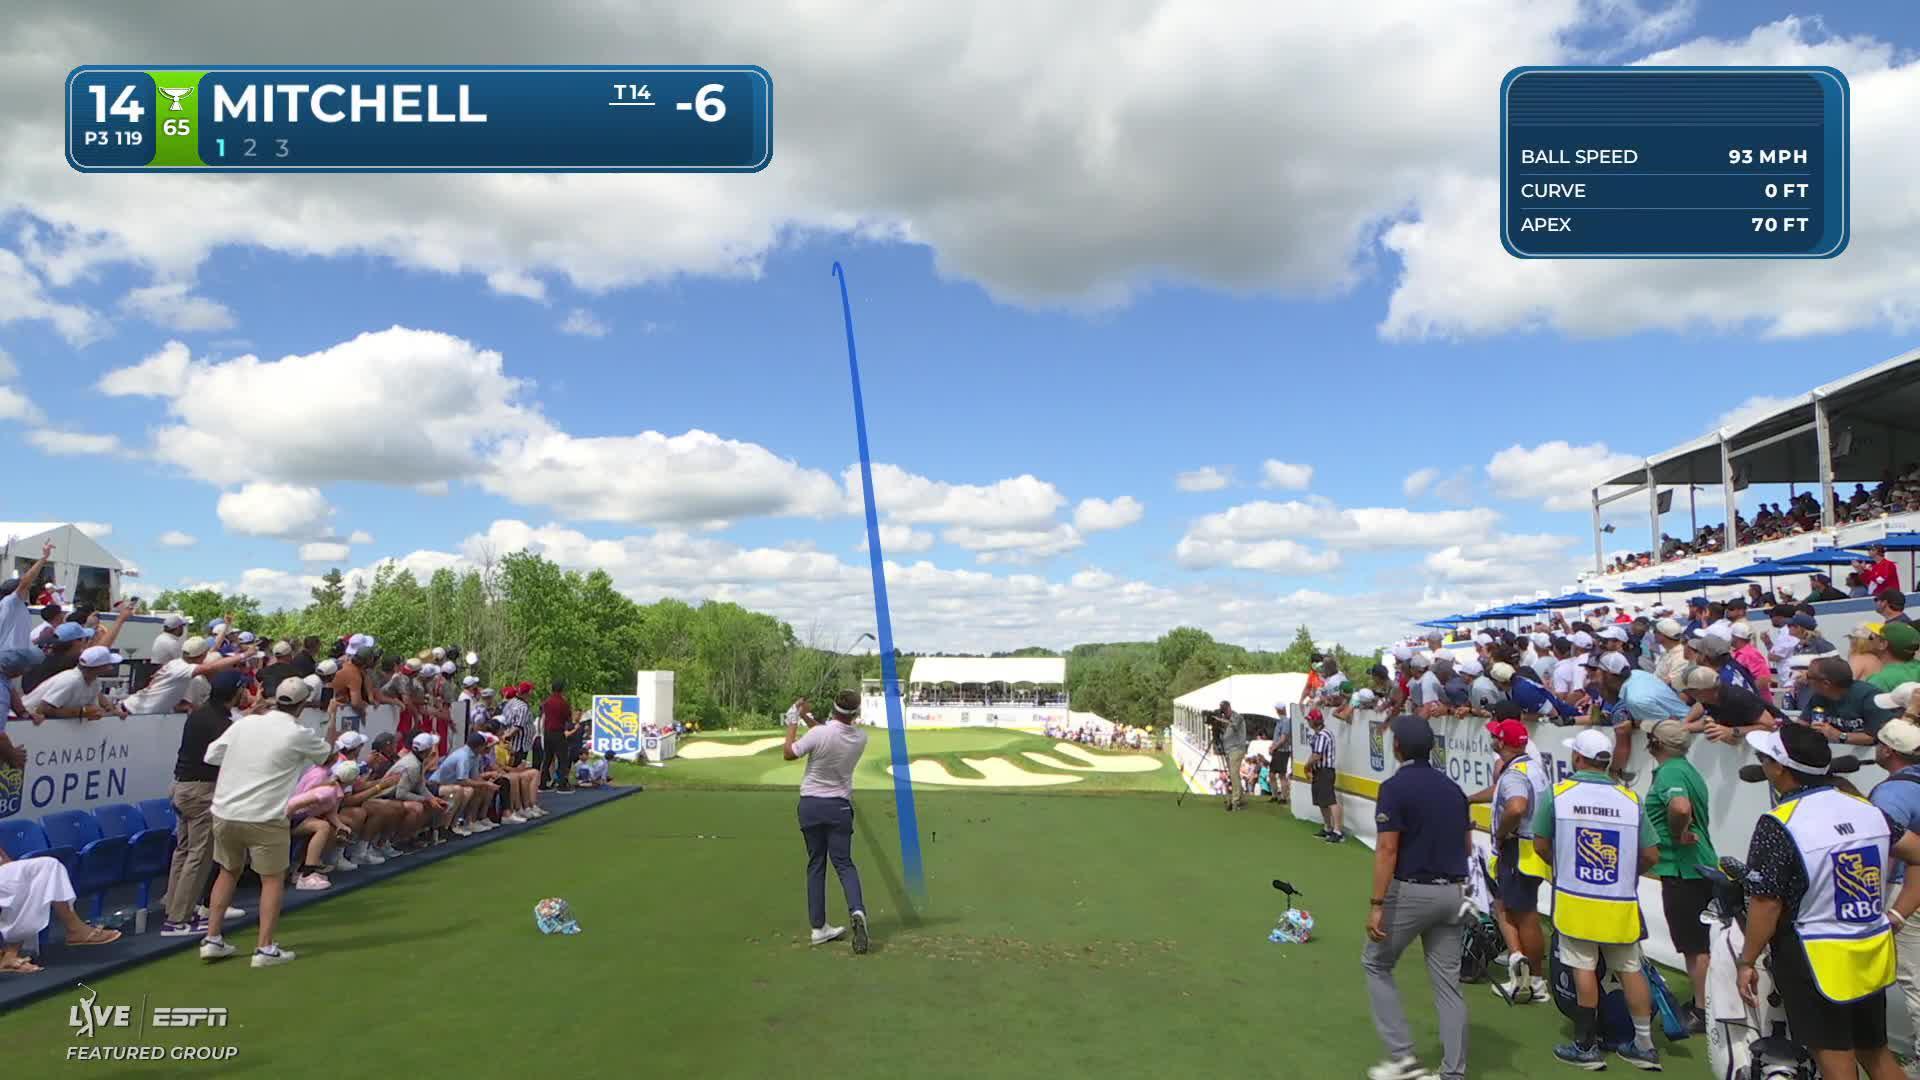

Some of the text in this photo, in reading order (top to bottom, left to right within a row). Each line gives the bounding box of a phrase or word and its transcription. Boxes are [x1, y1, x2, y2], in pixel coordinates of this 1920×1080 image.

[36, 736, 129, 766] CANADIAN
[598, 738, 636, 751] RBC
[1448, 734, 1490, 756] CANADIA
[31, 768, 127, 808] OPEN
[0, 797, 18, 813] BC
[1573, 805, 1622, 818] MITCHELL
[1833, 822, 1855, 836] WU
[1580, 866, 1616, 882] RBC
[1841, 898, 1881, 919] RBC
